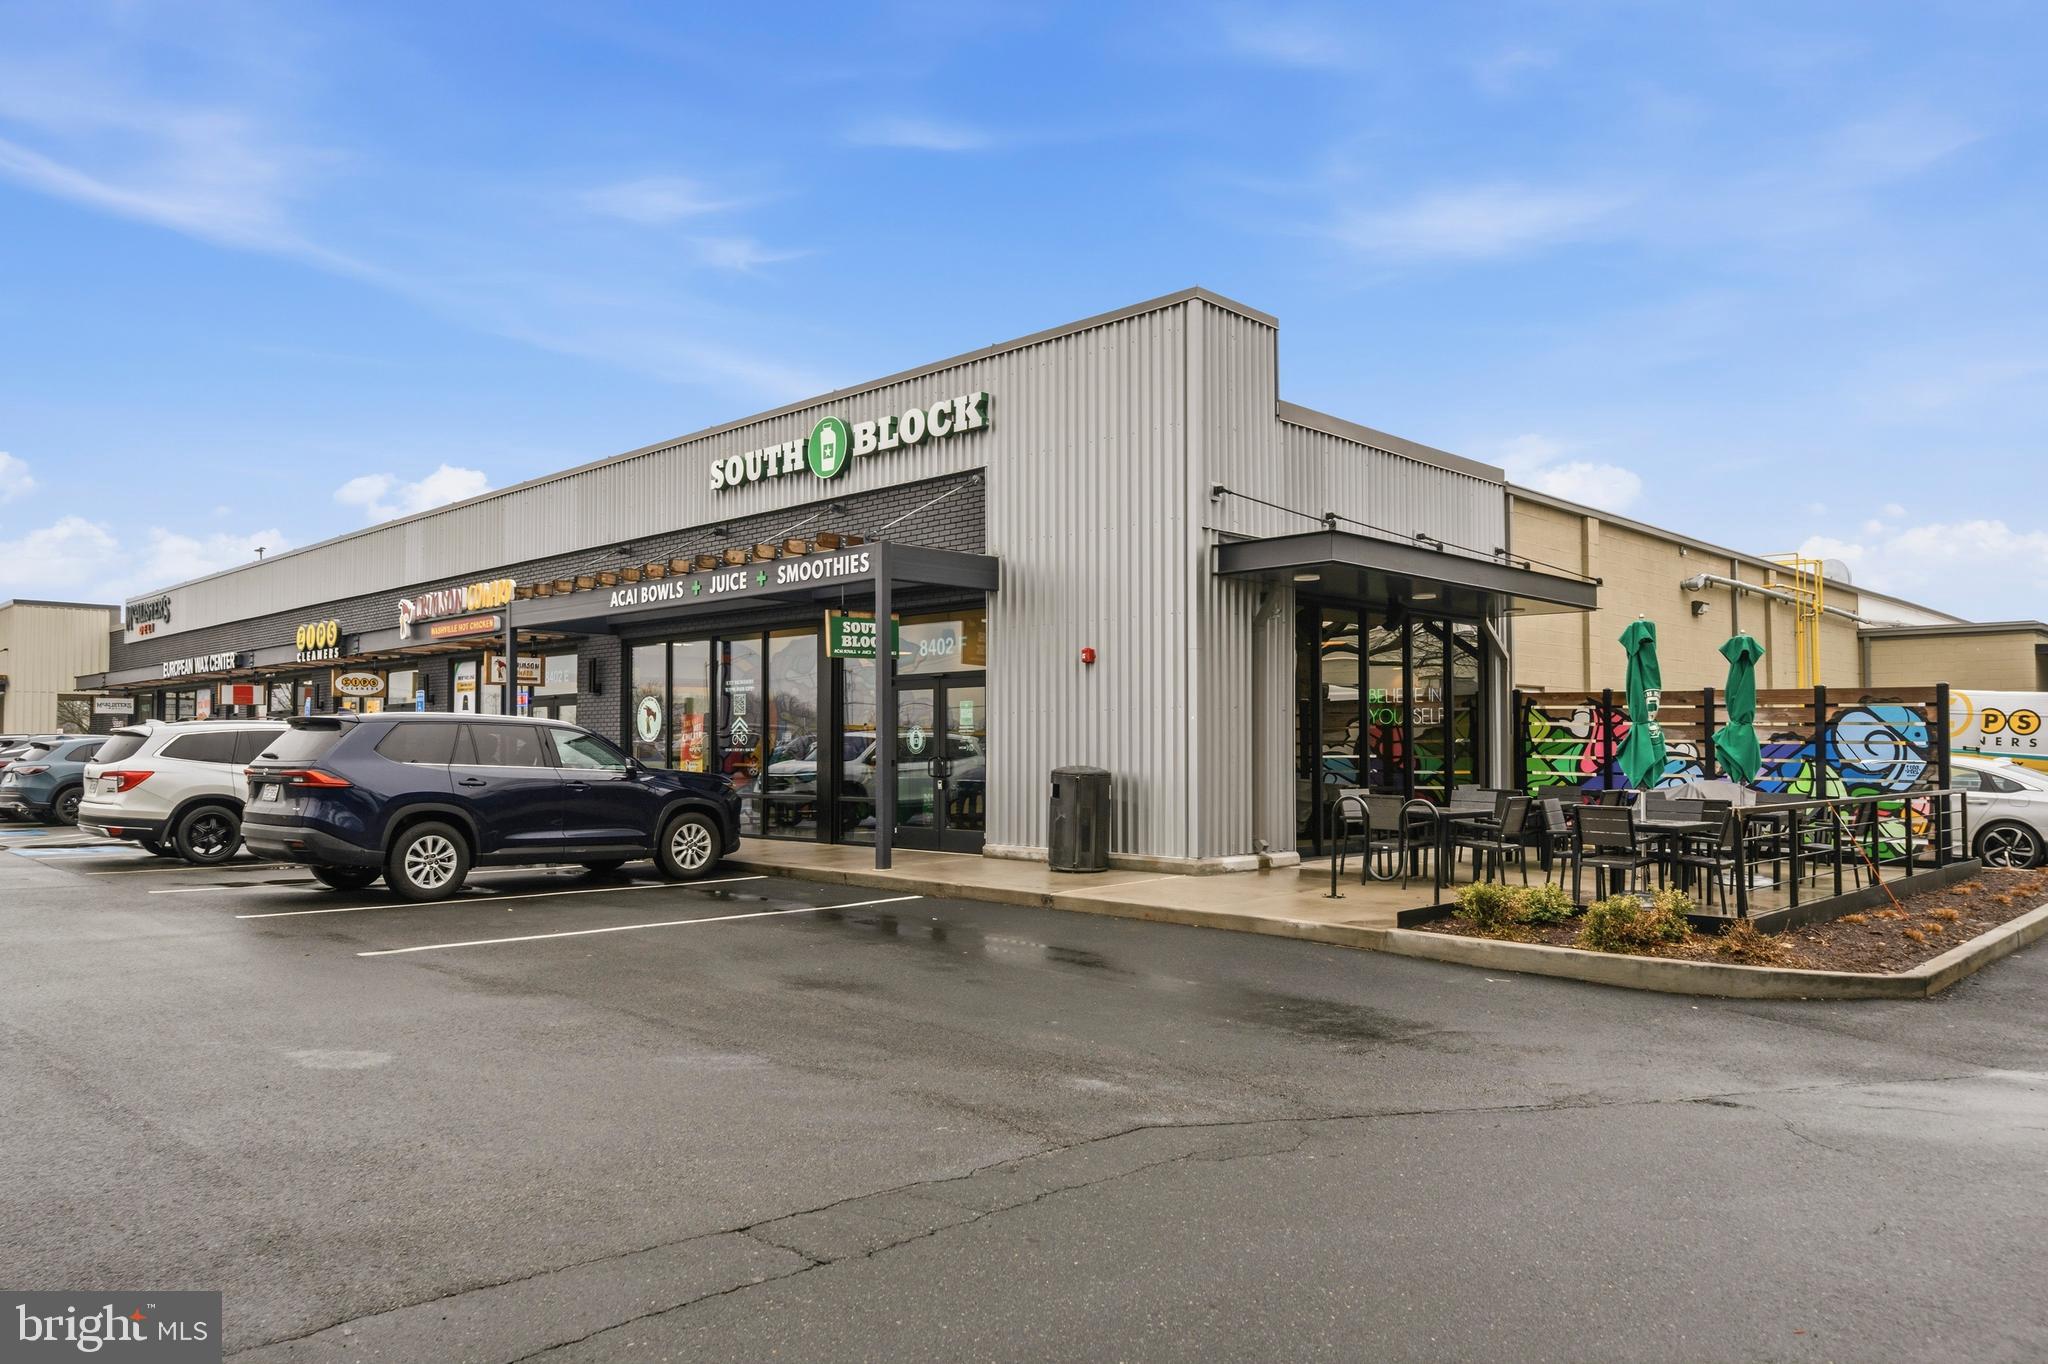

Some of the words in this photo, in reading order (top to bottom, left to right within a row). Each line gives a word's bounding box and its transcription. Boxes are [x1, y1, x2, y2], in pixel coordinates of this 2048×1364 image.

[711, 438, 808, 491] SOUTH
[852, 391, 989, 457] BLOCK
[610, 588, 638, 608] ACAI
[641, 580, 684, 602] BOWLS
[709, 571, 747, 593] JUICE
[777, 552, 870, 585] SMOOTHIES
[470, 618, 494, 630] CHICKEN
[842, 621, 876, 634] SOUT
[841, 635, 876, 647] BLOC
[919, 637, 954, 657] 8402
[296, 647, 339, 663] CLEANERS
[163, 659, 193, 678] EUROPEAN
[194, 655, 209, 674] WAX
[209, 652, 236, 671] CENTER
[1368, 687, 1424, 704] BELIEE
[1428, 687, 1442, 702] IN
[1369, 707, 1445, 725] YOUSELF
